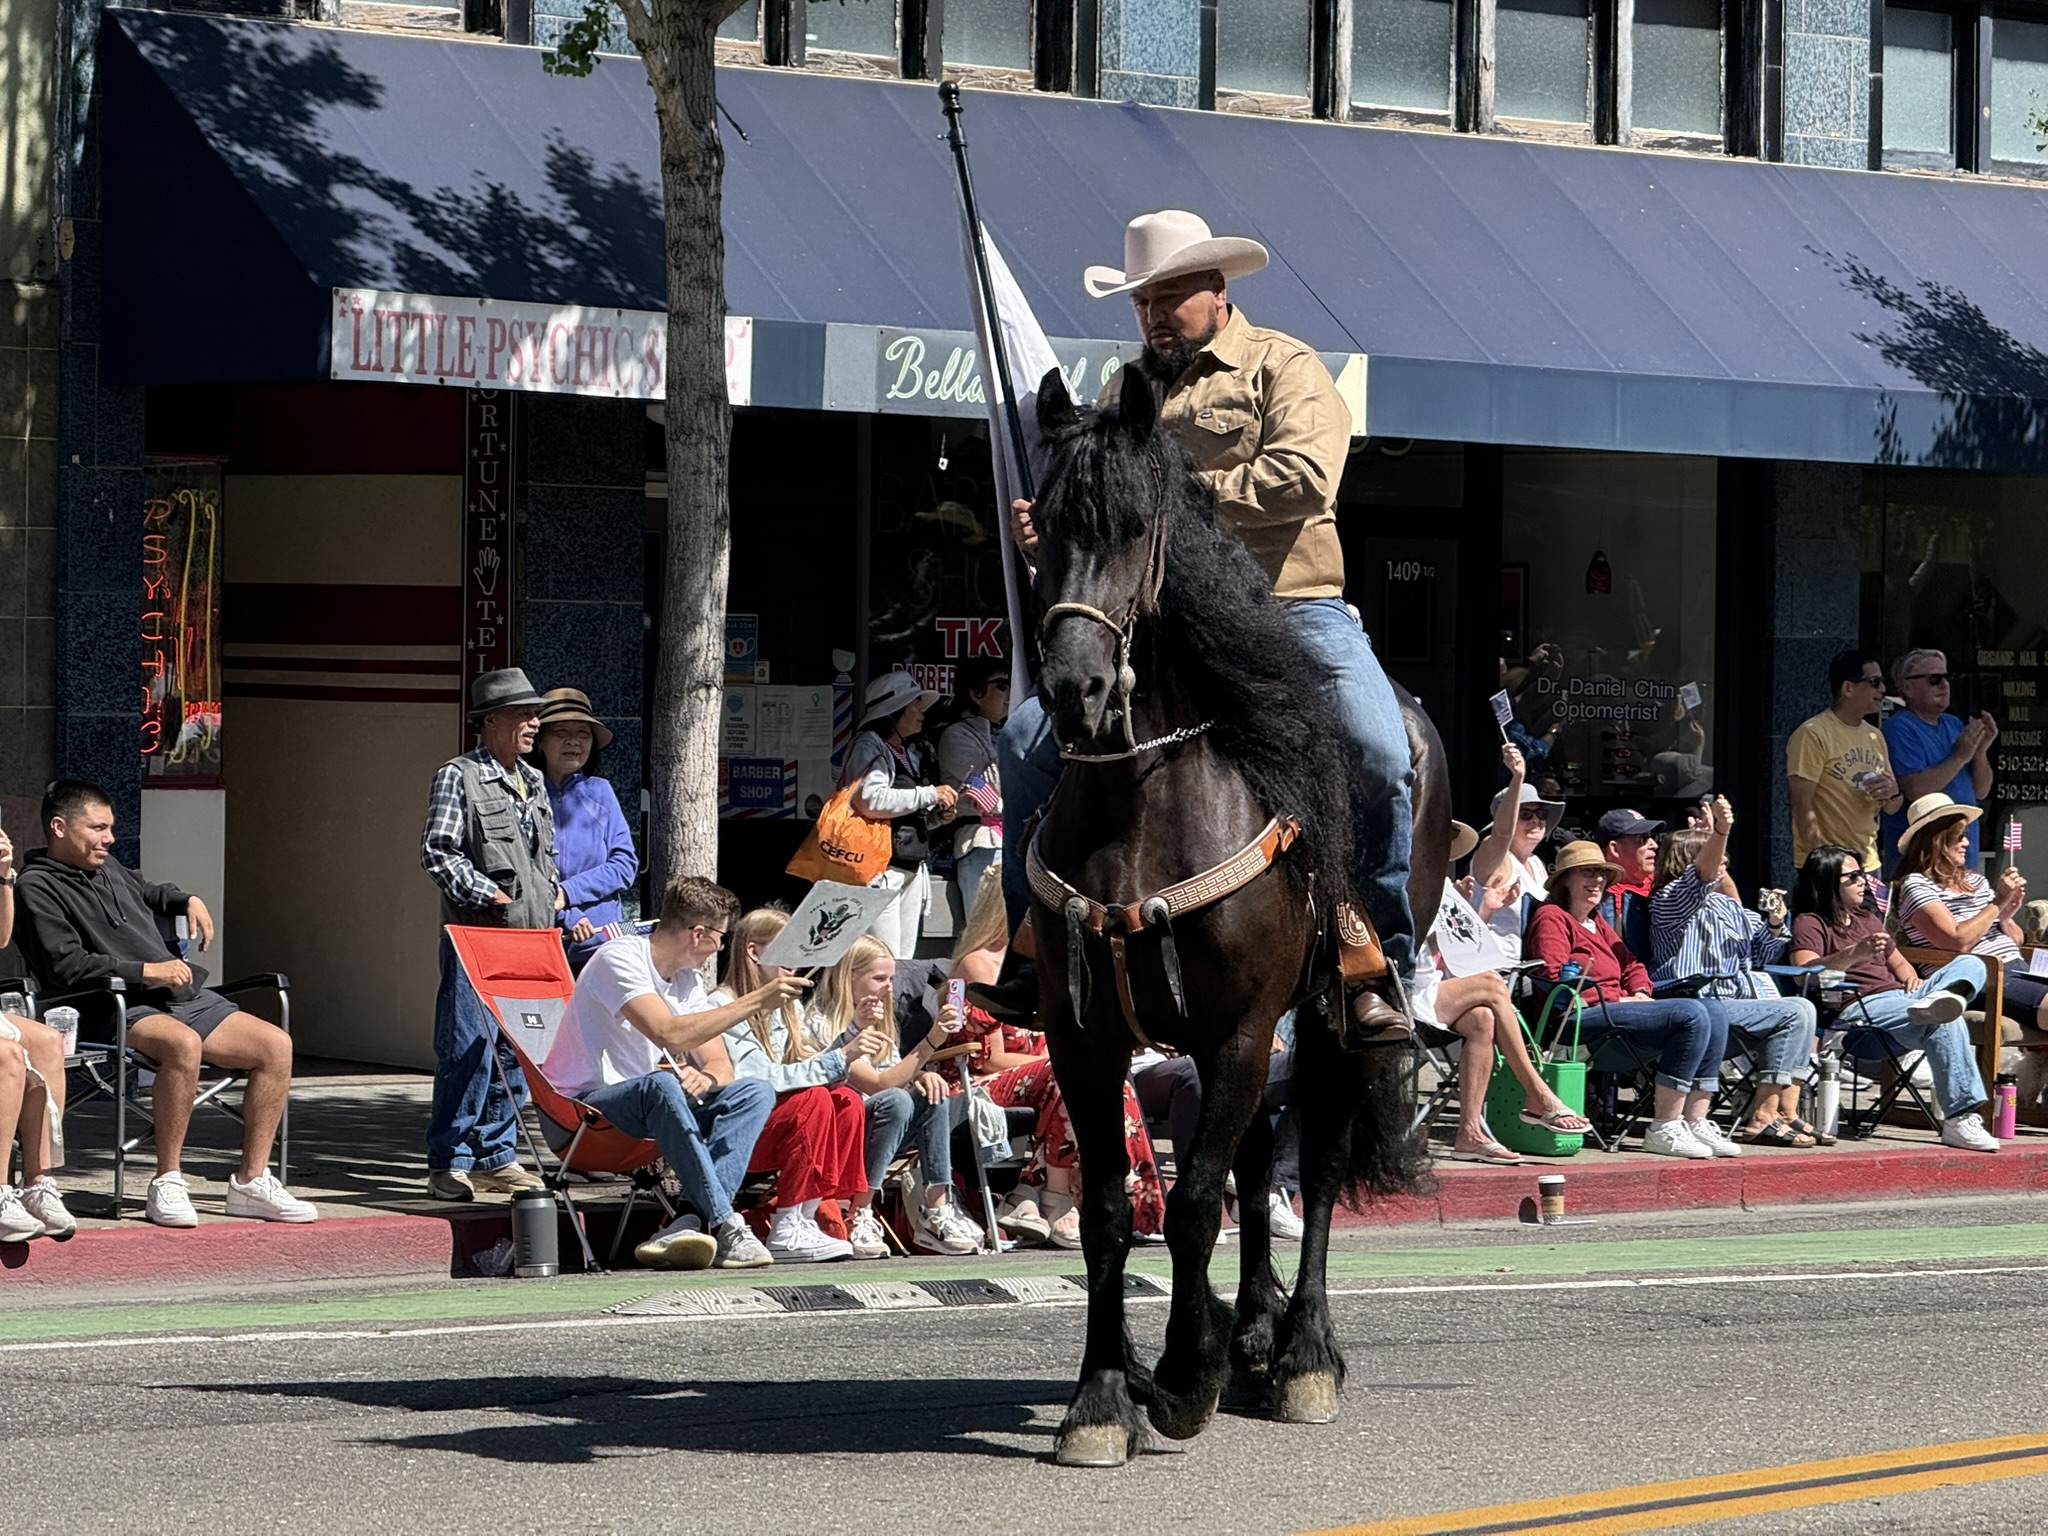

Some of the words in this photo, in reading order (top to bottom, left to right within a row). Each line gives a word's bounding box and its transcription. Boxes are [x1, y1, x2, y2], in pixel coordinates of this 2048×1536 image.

[350, 307, 476, 379] LITTLE
[485, 317, 634, 391] PSYCHIC
[885, 335, 986, 404] Bella
[1386, 560, 1421, 581] 1409
[1422, 566, 1436, 577] 1/2
[935, 617, 1004, 658] TK
[2019, 650, 2039, 667] NAIL
[1537, 677, 1561, 694] Dr.
[1570, 678, 1626, 697] Daniel
[1634, 680, 1675, 698] Chin
[2003, 681, 2037, 697] WAXING
[1552, 700, 1659, 721] Optometrist
[2001, 730, 2042, 746] MASSAGE
[732, 765, 780, 780] BARBER
[1827, 762, 1848, 781] UC
[1844, 747, 1865, 768] SAN
[740, 785, 772, 799] SHOP
[820, 840, 864, 863] CEFCU
